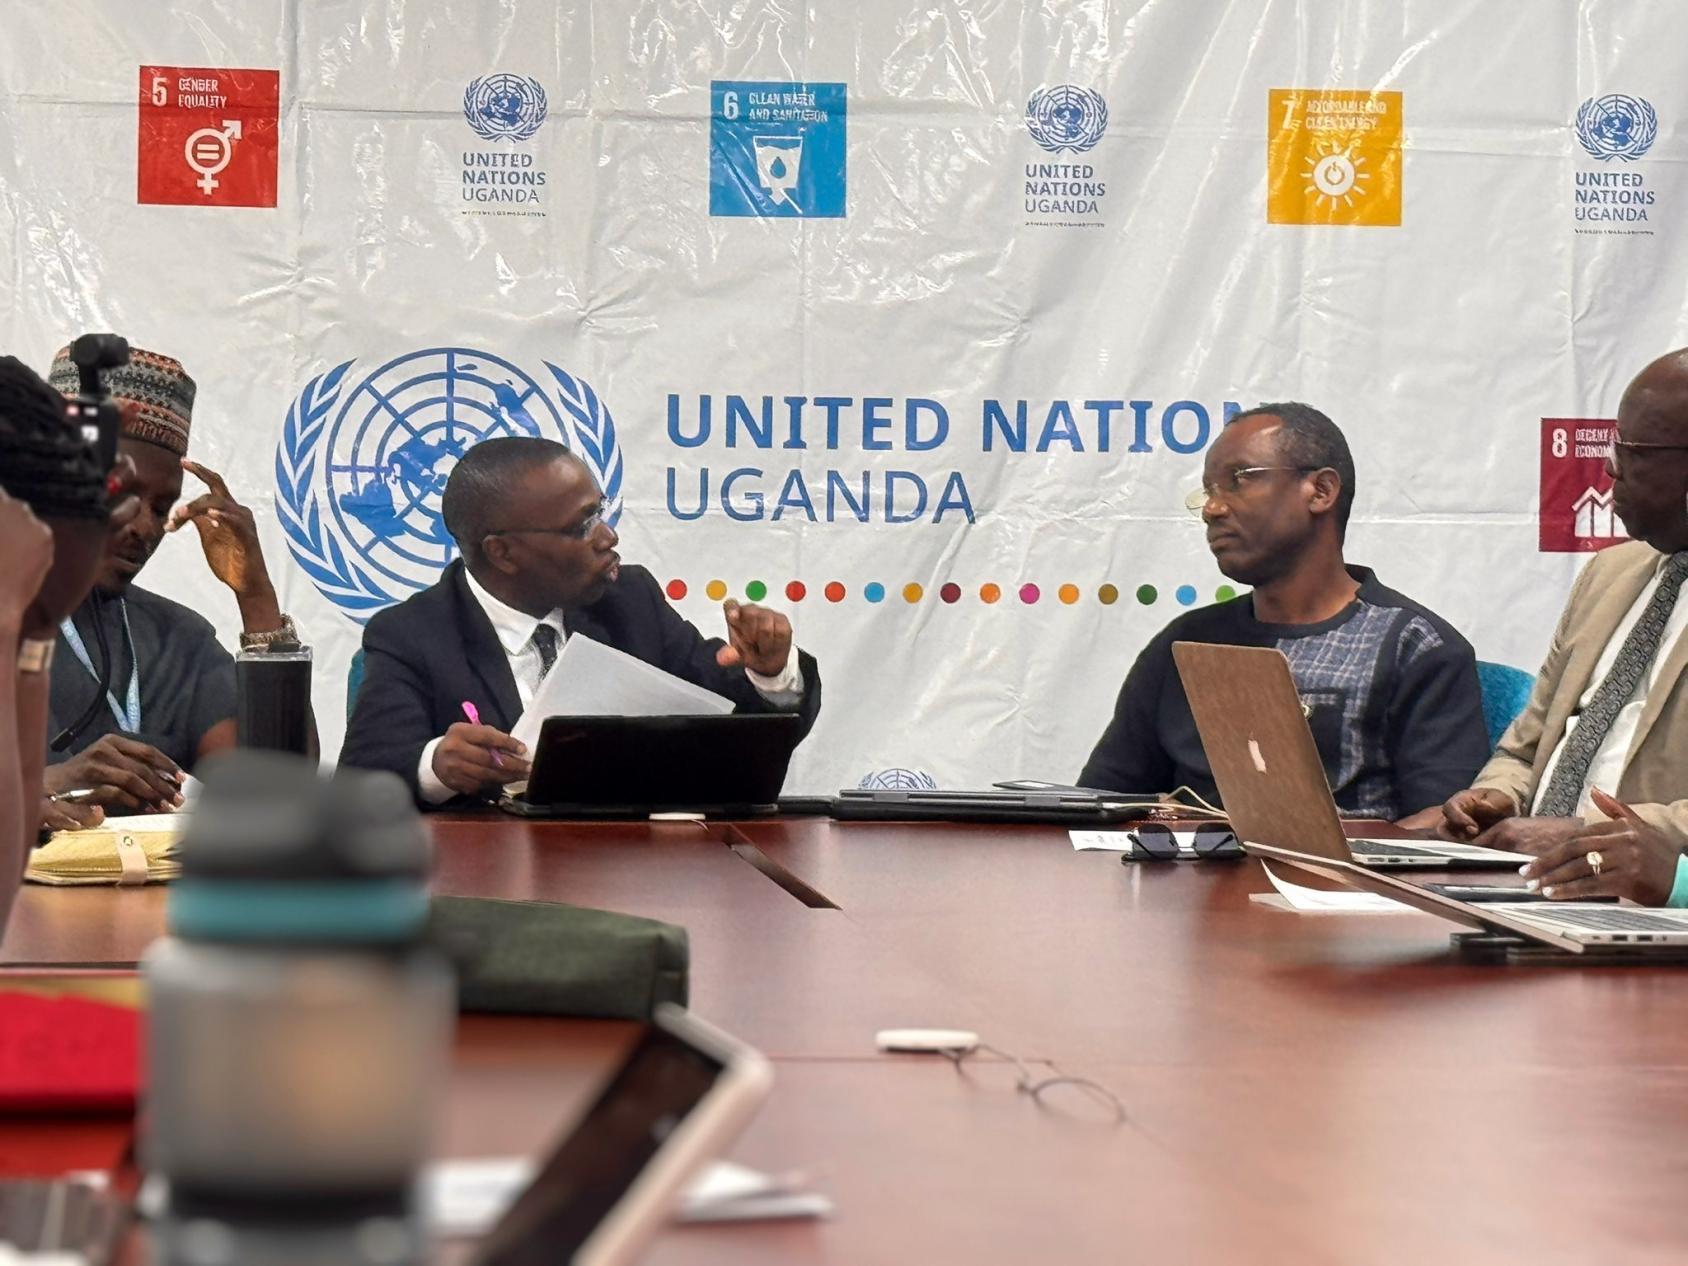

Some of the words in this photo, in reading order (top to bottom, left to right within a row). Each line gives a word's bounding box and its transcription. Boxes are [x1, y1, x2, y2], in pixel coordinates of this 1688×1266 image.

[152, 77, 168, 107] 5
[178, 77, 219, 92] GENDER
[178, 94, 228, 109] EQUALITY
[723, 91, 739, 120] 6
[748, 92, 781, 106] CLEAN
[463, 152, 533, 168] UNITED
[462, 170, 547, 186] NATIONS
[1025, 163, 1094, 179] UNITED
[1575, 172, 1644, 188] UNITED
[462, 188, 541, 204] UGANDA
[1025, 181, 1106, 197] NATIONS
[1575, 189, 1655, 205] NATIONS
[1025, 199, 1099, 214] UGANDA
[1575, 207, 1648, 222] UGANDA
[667, 393, 950, 452] UNITED
[982, 399, 1241, 454] NATIO
[1551, 428, 1568, 458] 8
[1575, 444, 1612, 458] ECONOM
[667, 467, 976, 525] UGANDA
